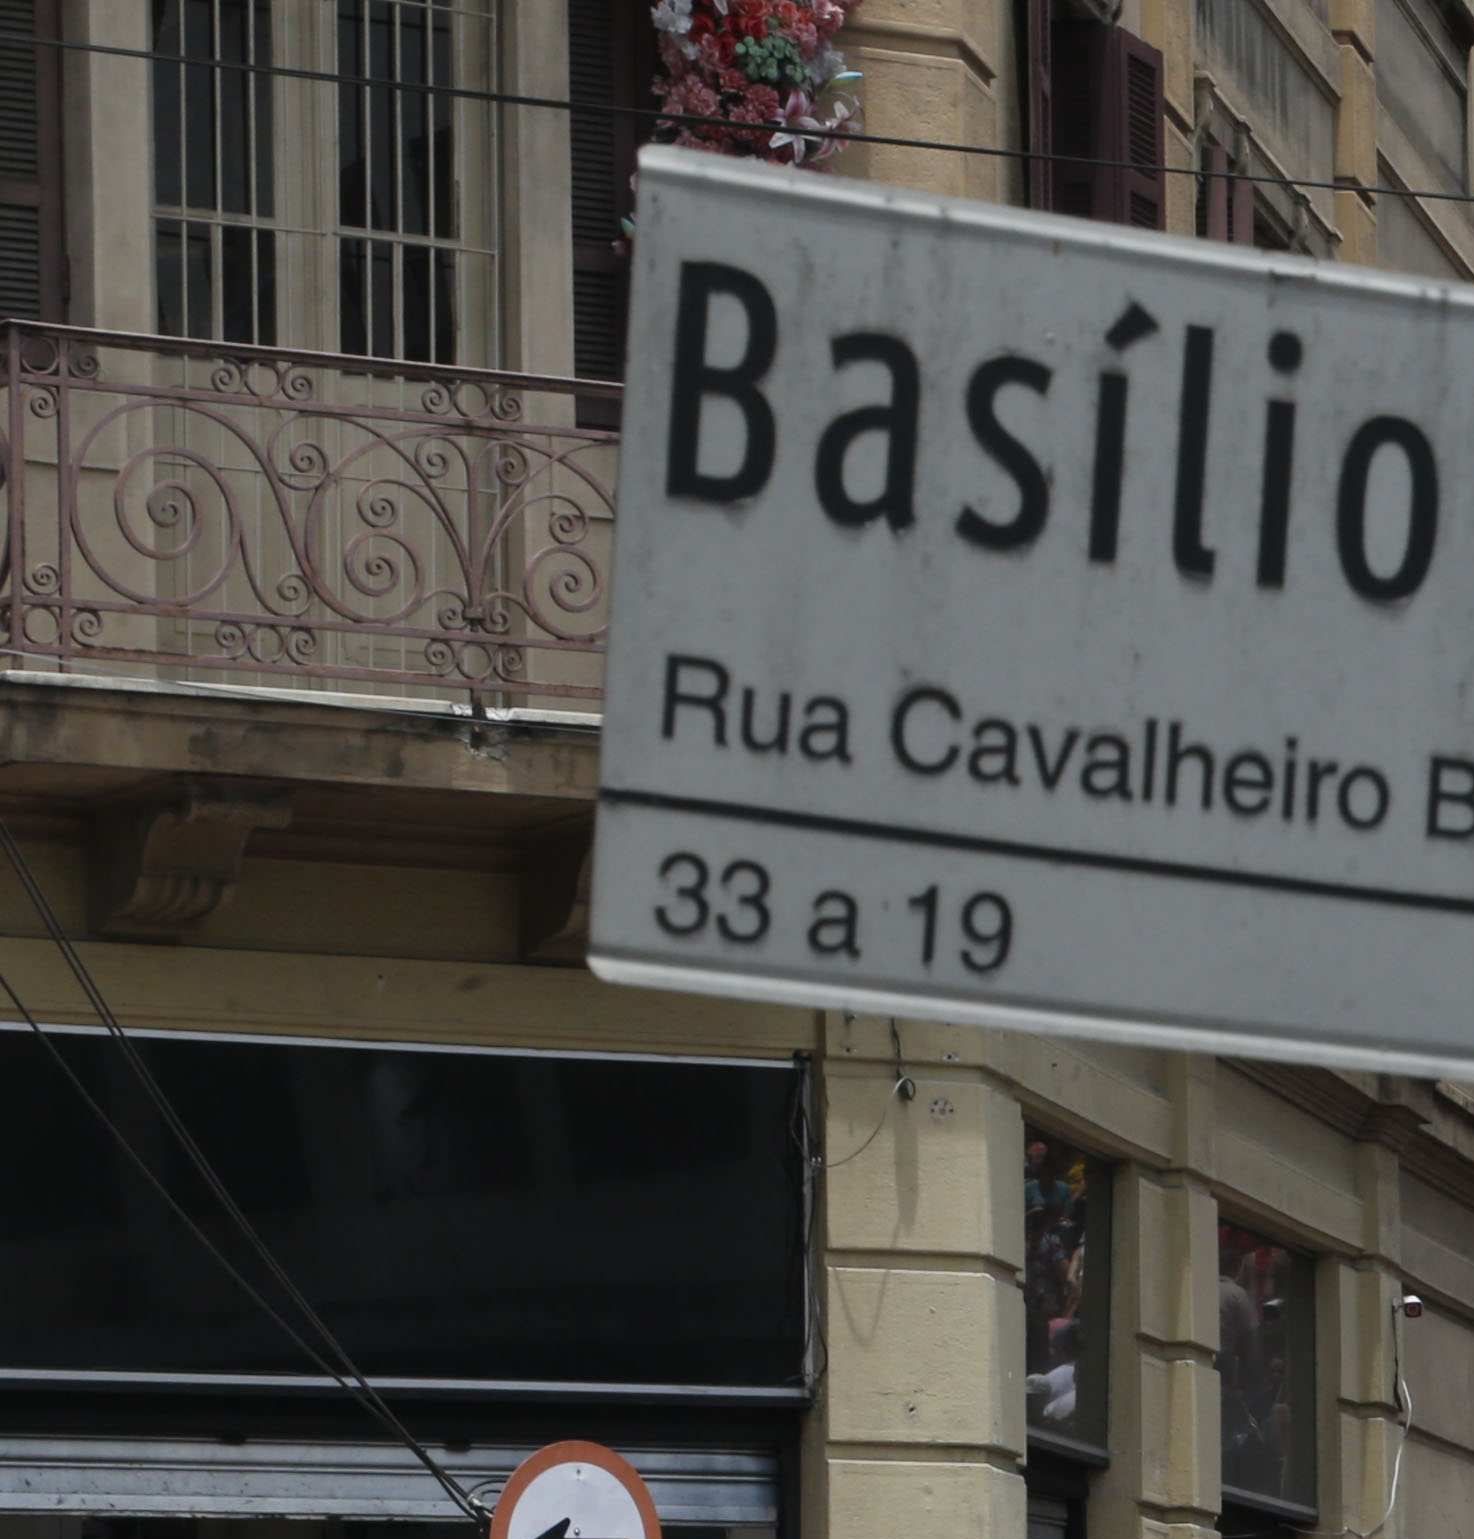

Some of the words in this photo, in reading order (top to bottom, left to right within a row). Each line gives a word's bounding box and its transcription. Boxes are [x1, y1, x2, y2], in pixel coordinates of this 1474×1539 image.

[666, 261, 1440, 606] Basílio
[661, 654, 852, 766] Rua
[890, 684, 1390, 832] Cavalheiro
[654, 852, 770, 944] 33
[807, 890, 860, 958] a
[907, 884, 1012, 974] 19
